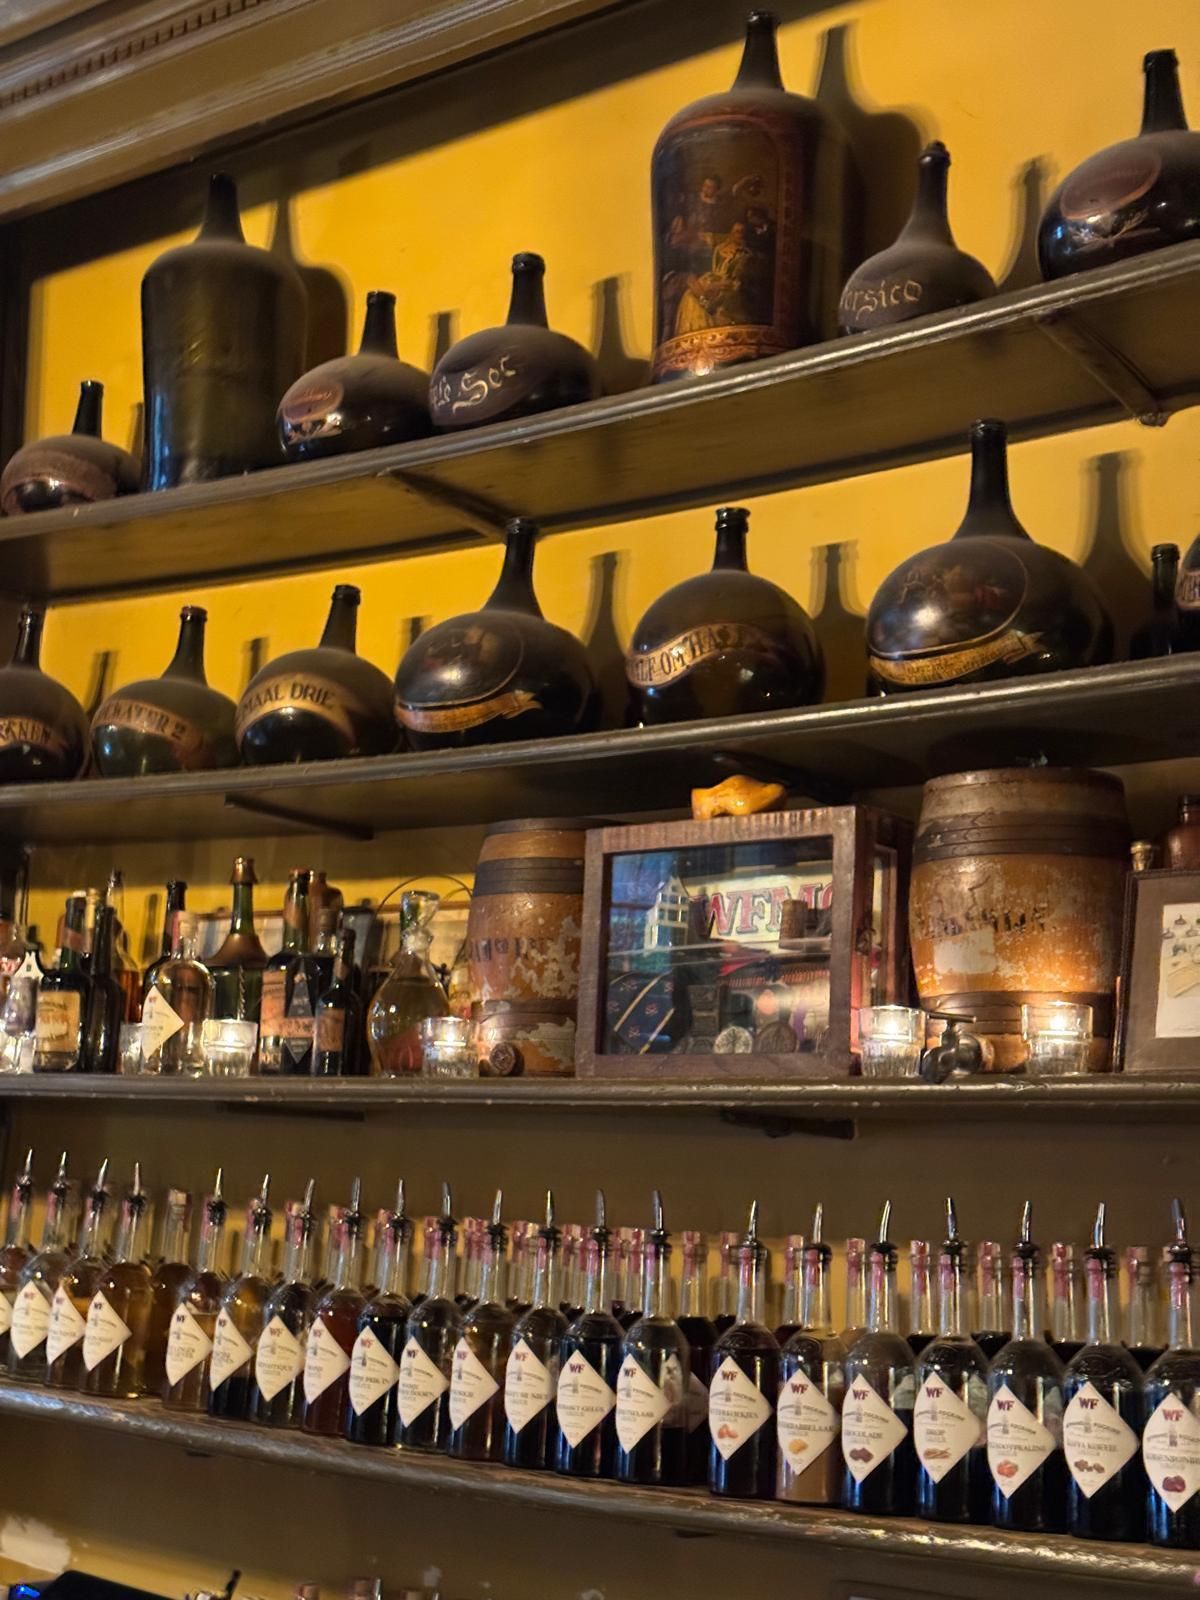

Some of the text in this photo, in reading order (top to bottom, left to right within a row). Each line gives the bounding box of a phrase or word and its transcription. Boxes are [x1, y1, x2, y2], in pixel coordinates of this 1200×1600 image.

[569, 1363, 586, 1374] WF
[623, 1367, 637, 1378] WF
[721, 1370, 738, 1381] WF
[790, 1383, 809, 1394] WF
[925, 1387, 944, 1398] WF
[852, 1389, 870, 1401] WF
[996, 1400, 1015, 1411] WF
[1078, 1397, 1099, 1409] WF
[1162, 1409, 1185, 1421] WF
